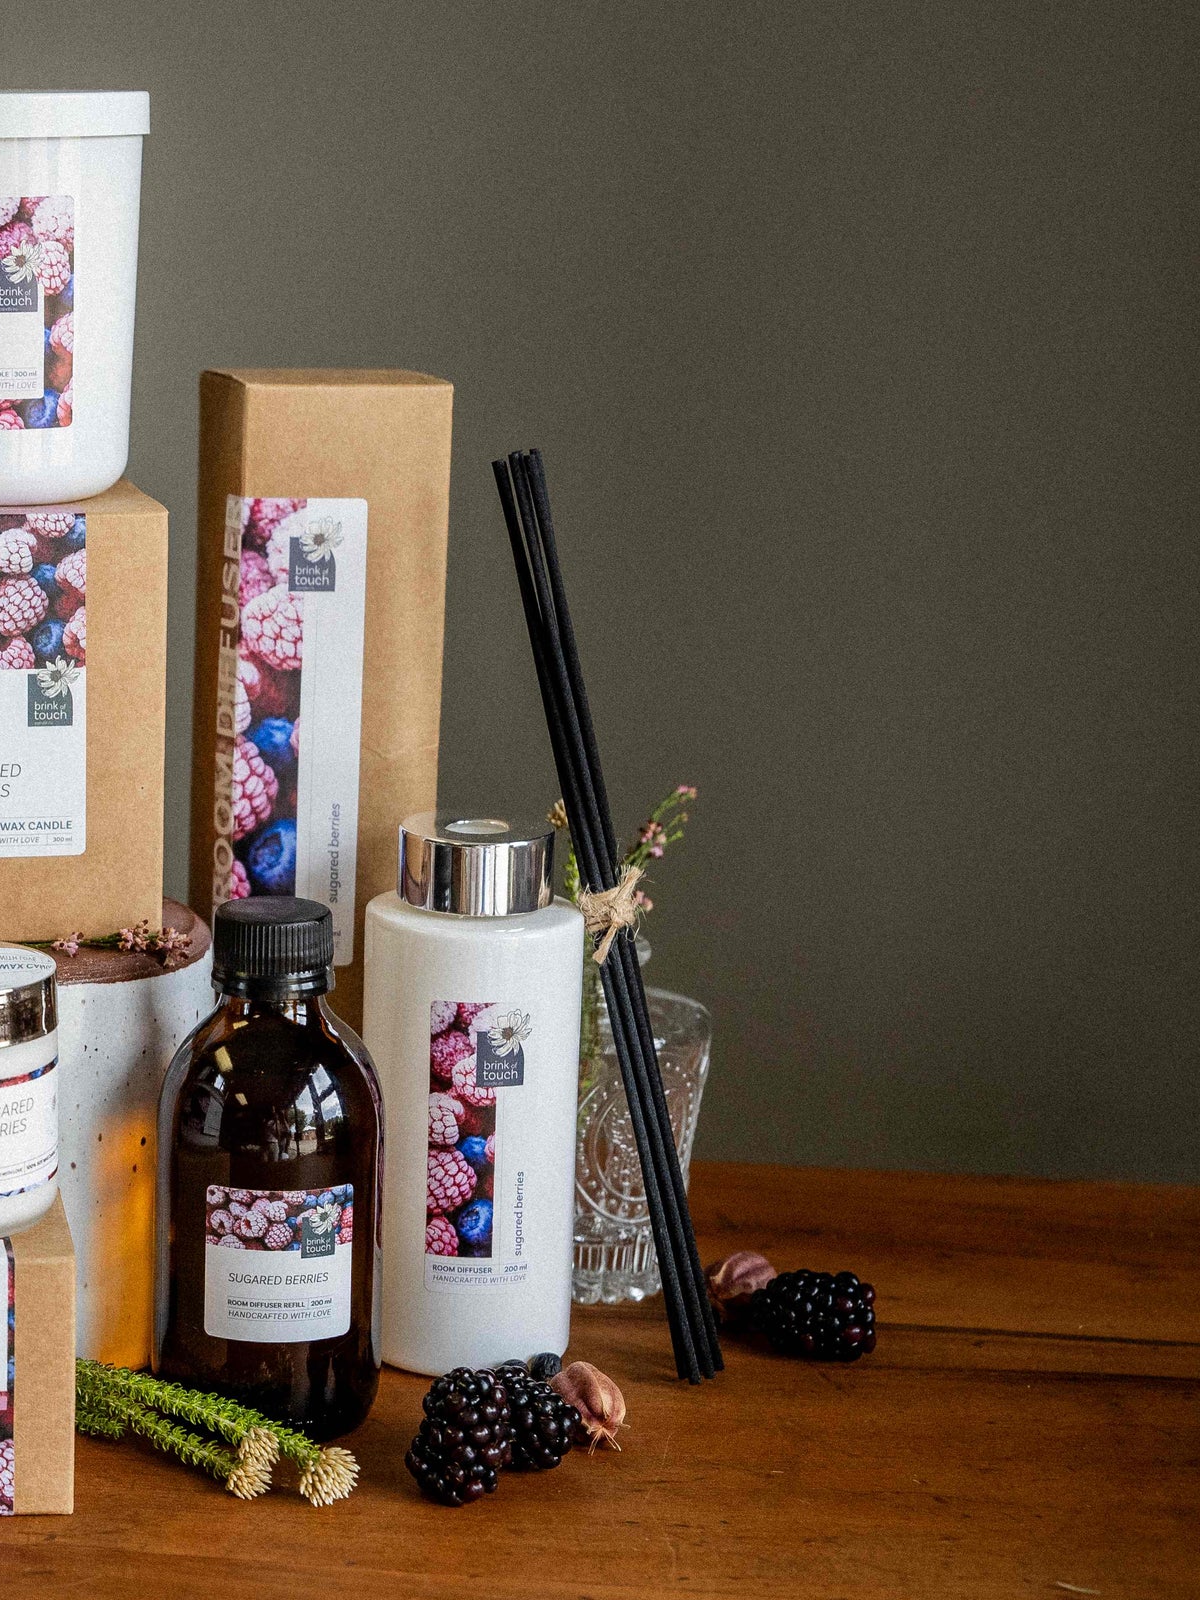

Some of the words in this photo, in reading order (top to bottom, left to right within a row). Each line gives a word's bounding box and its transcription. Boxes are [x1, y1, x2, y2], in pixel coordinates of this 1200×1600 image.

[16, 380, 37, 390] LOVE
[296, 565, 320, 575] brink
[294, 574, 330, 586] touch
[34, 700, 58, 710] brink
[34, 710, 68, 720] touch
[0, 822, 26, 831] WAX
[28, 820, 73, 830] CANDLE
[328, 803, 340, 848] berries
[328, 851, 342, 904] sugared
[483, 1060, 510, 1070] brink
[483, 1069, 518, 1080] touch
[514, 1171, 524, 1208] berries
[514, 1212, 526, 1256] sugared
[306, 1236, 326, 1246] brink
[306, 1244, 332, 1254] touch
[432, 1264, 456, 1273] ROOM
[456, 1266, 492, 1274] DIFFUSER
[504, 1265, 518, 1273] 200
[228, 1272, 282, 1286] SUGARED
[285, 1272, 329, 1286] BERRIES
[432, 1274, 488, 1284] HANDCRAFTED
[489, 1275, 508, 1284] WITH
[508, 1274, 527, 1282] LOVE
[228, 1299, 248, 1308] ROOM
[250, 1301, 282, 1309] DIFFUSER
[228, 1310, 288, 1320] HANDCRAFTED
[290, 1312, 312, 1320] WITH
[312, 1309, 332, 1318] LOVE
